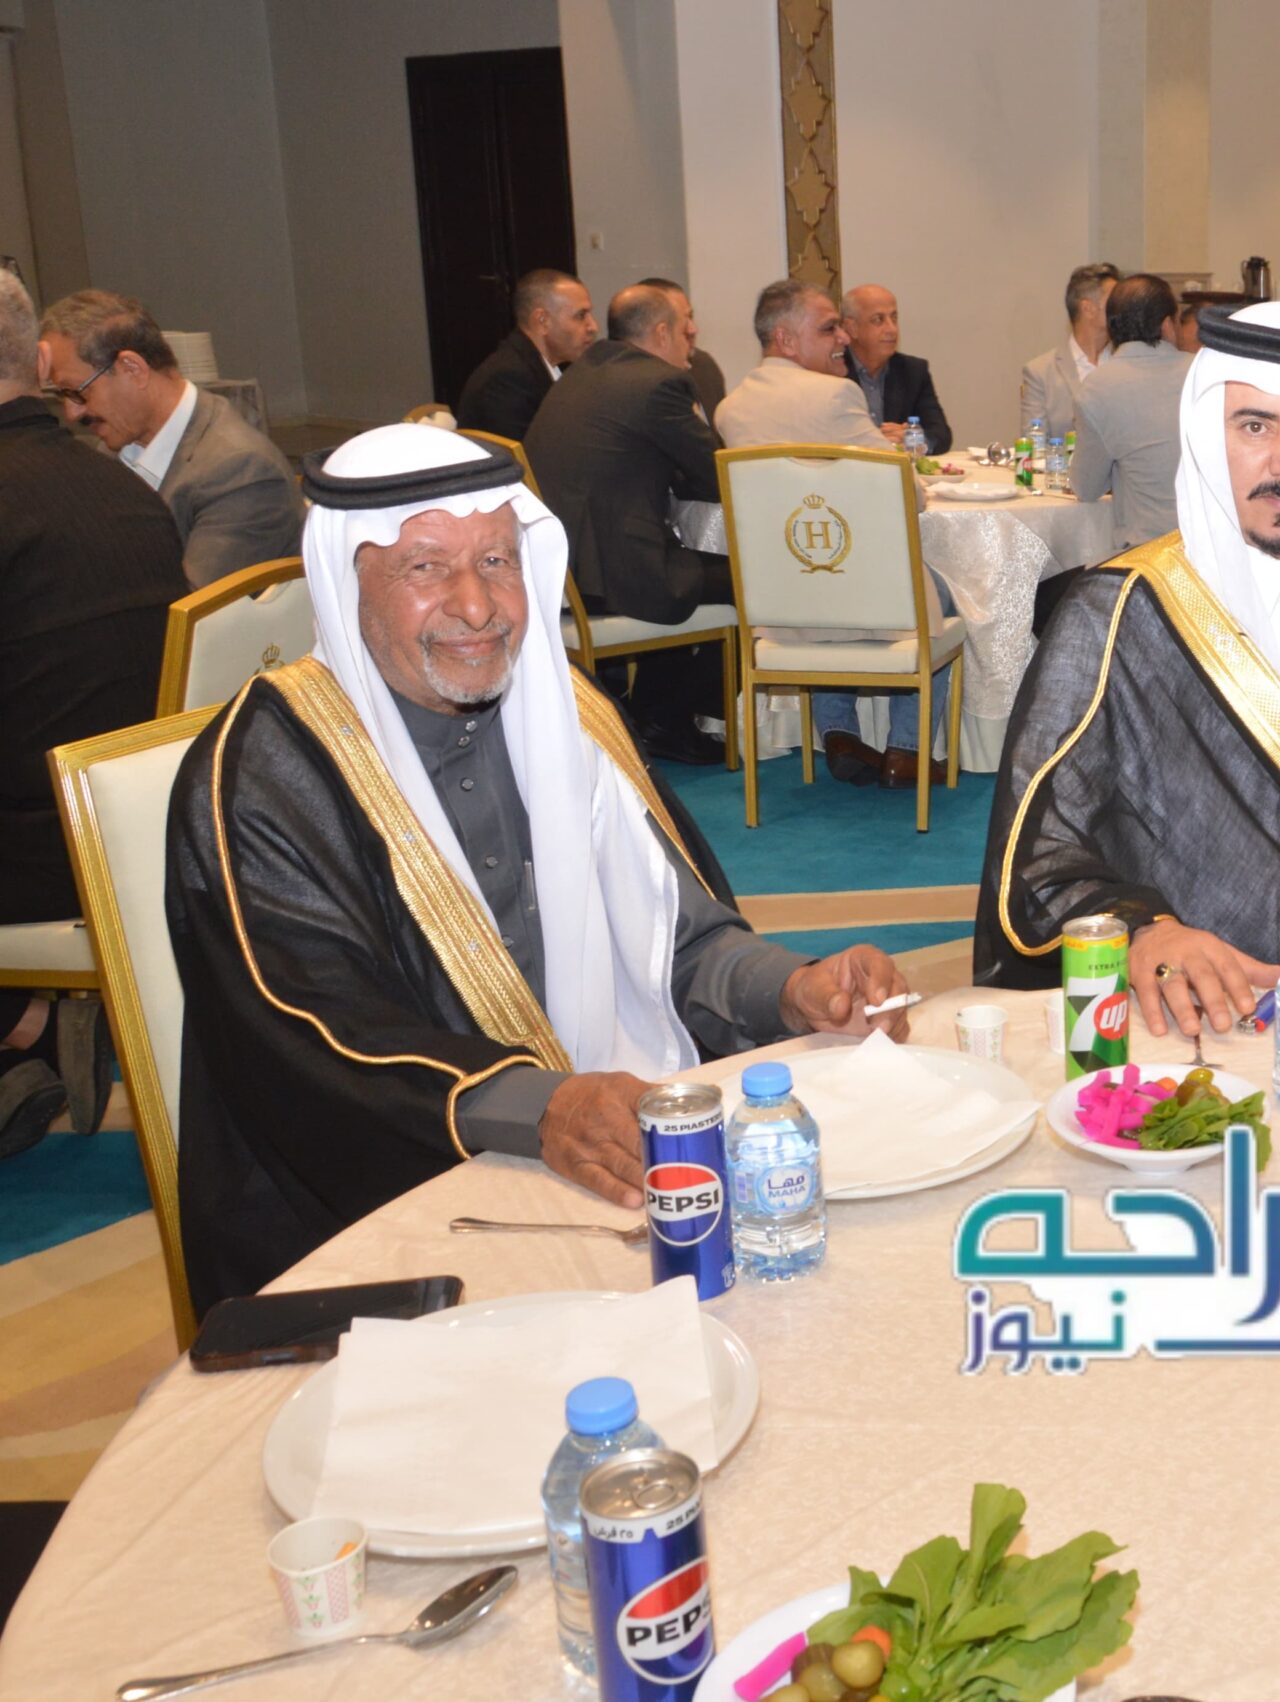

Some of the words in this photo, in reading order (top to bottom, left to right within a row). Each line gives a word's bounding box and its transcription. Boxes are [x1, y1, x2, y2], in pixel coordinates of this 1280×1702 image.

[801, 520, 833, 550] H
[664, 1125, 679, 1133] 25
[767, 1175, 805, 1190] مها
[768, 1185, 806, 1198] MAHA
[646, 1188, 719, 1213] PEPSI
[626, 1597, 710, 1647] PEP
